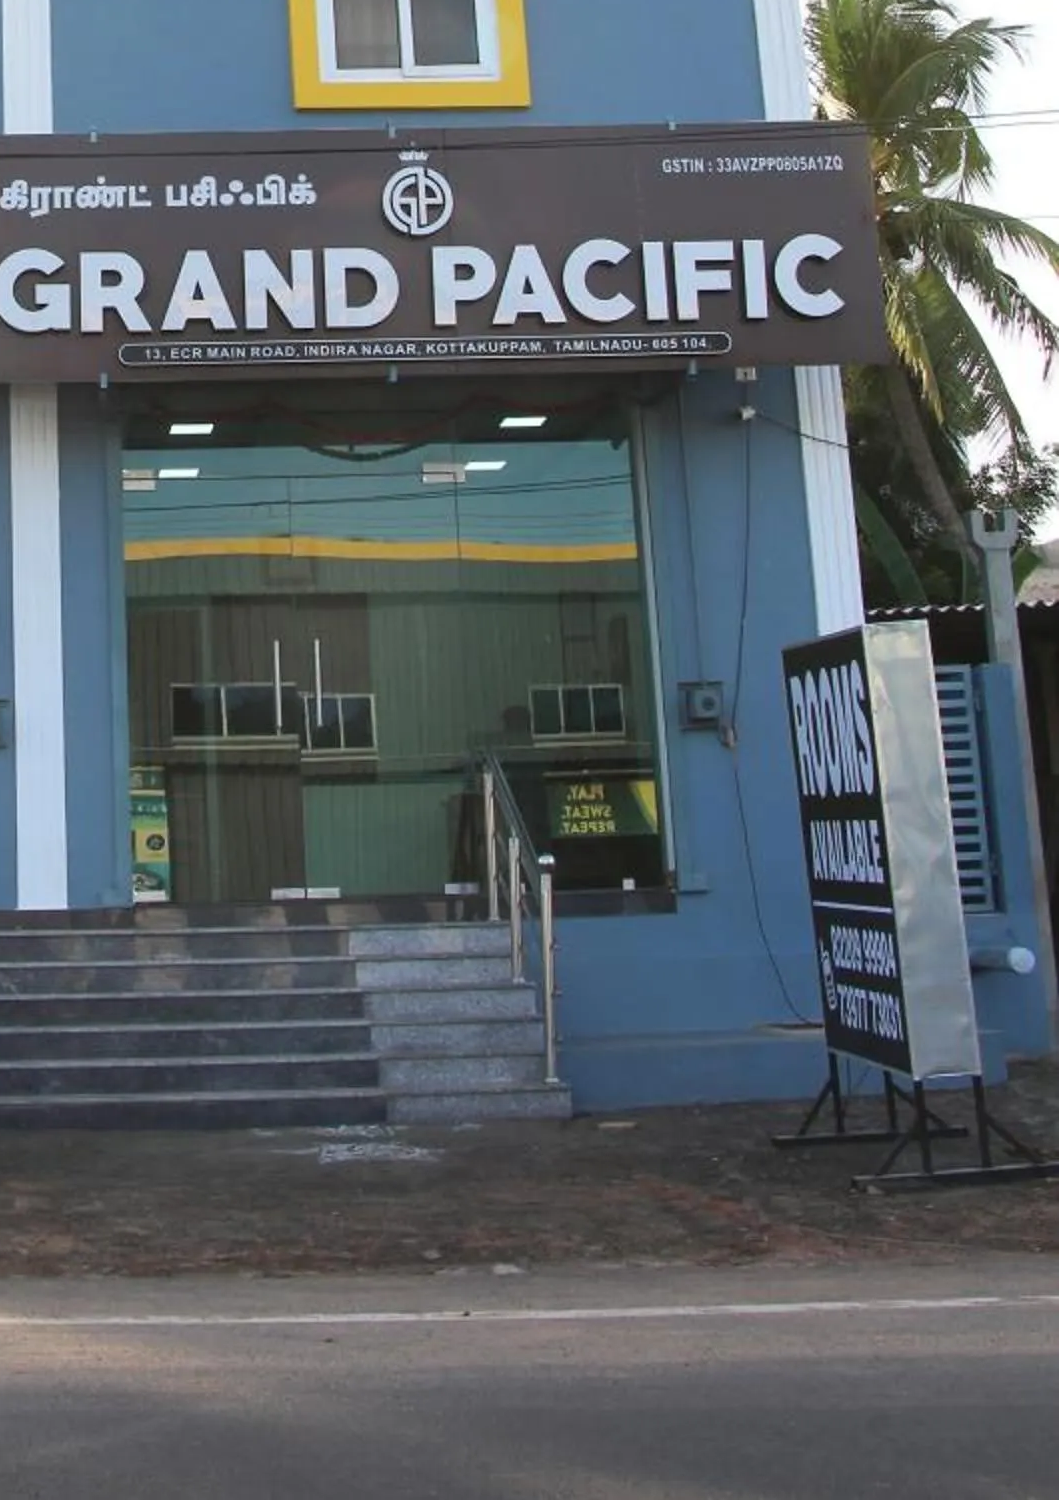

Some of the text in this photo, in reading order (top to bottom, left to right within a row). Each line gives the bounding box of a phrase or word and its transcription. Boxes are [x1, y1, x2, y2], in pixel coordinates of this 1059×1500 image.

[662, 158, 704, 173] GSTIN
[432, 234, 845, 326] PACIFIC
[145, 348, 167, 361] 13,
[170, 347, 203, 360] ECR
[206, 346, 246, 359] MAIN
[250, 344, 300, 358] ROAD,
[304, 343, 355, 357] INDIRA
[360, 341, 422, 356] NAGAR,
[426, 340, 546, 355] KOTTAKUPPAM,
[790, 661, 874, 797] ROOMS
[810, 819, 885, 884] AVAILABLE
